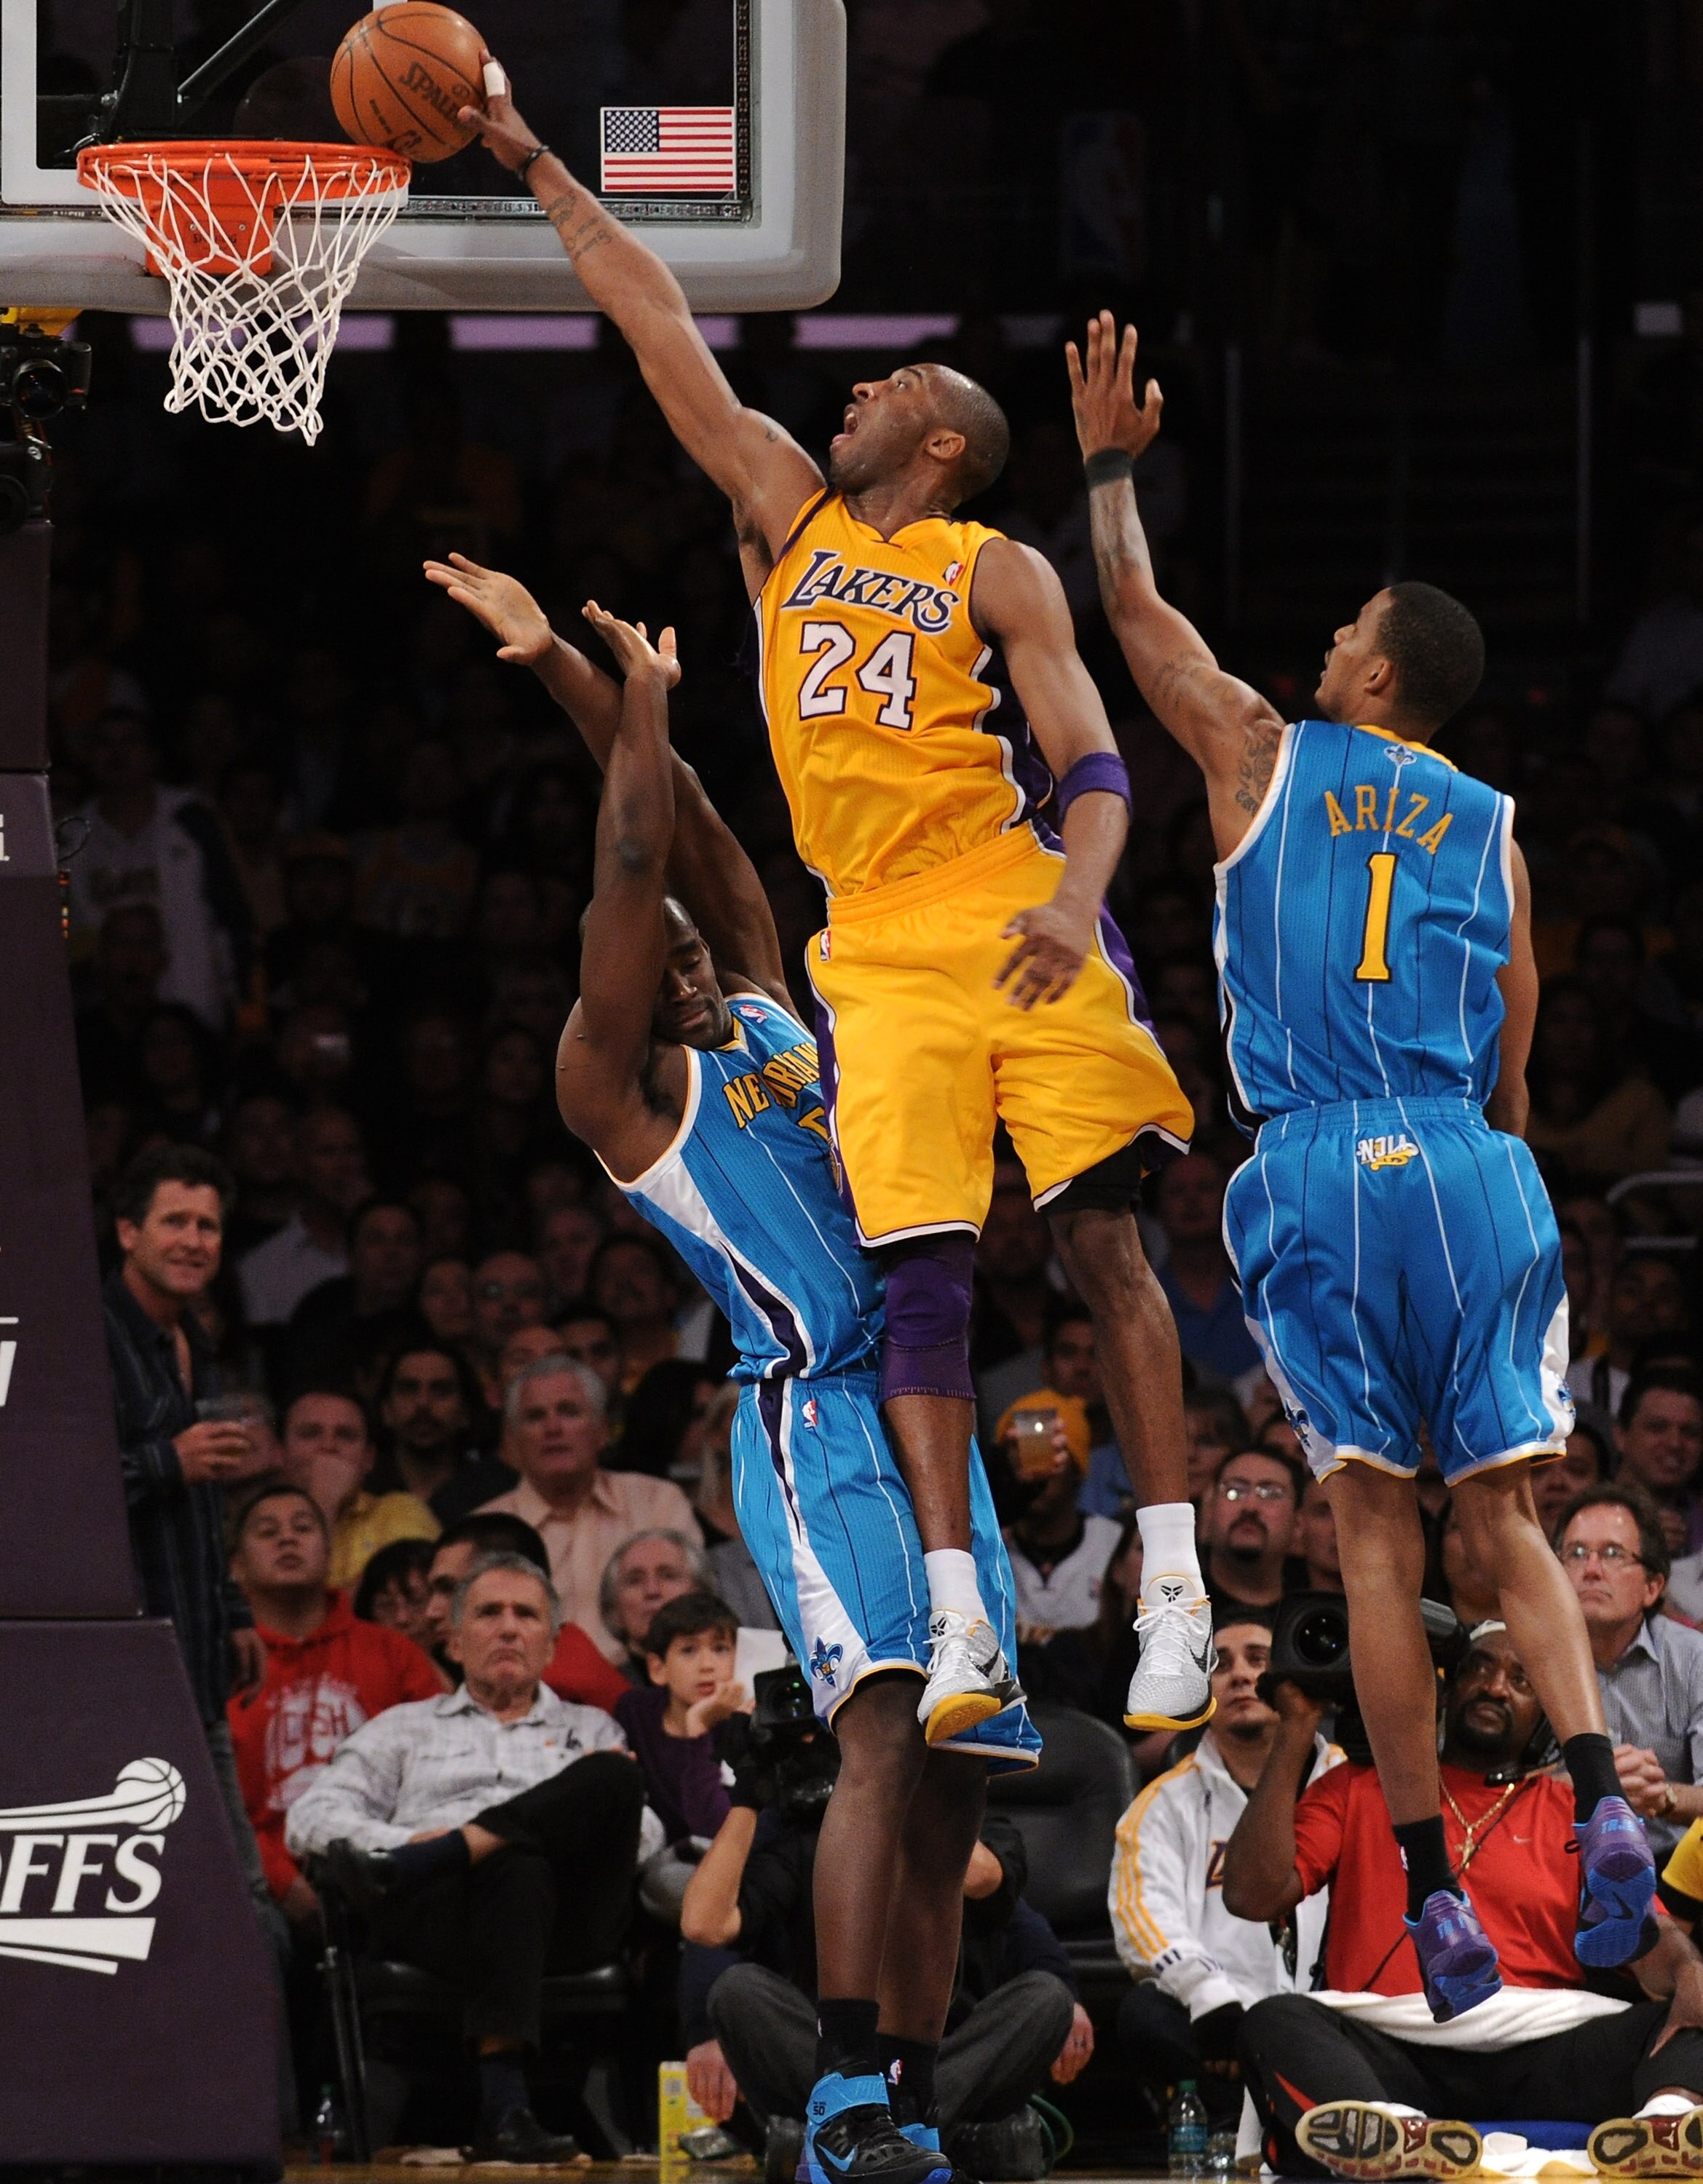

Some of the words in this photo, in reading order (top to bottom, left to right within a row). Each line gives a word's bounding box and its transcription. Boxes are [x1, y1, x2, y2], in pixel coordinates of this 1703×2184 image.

[399, 61, 465, 127] SPALD
[780, 550, 963, 635] LAKERS
[799, 621, 917, 731] 24
[1324, 785, 1453, 855] ARIZA
[1354, 852, 1398, 983] 1
[722, 1072, 770, 1129] NE
[0, 1834, 166, 1913] FFS
